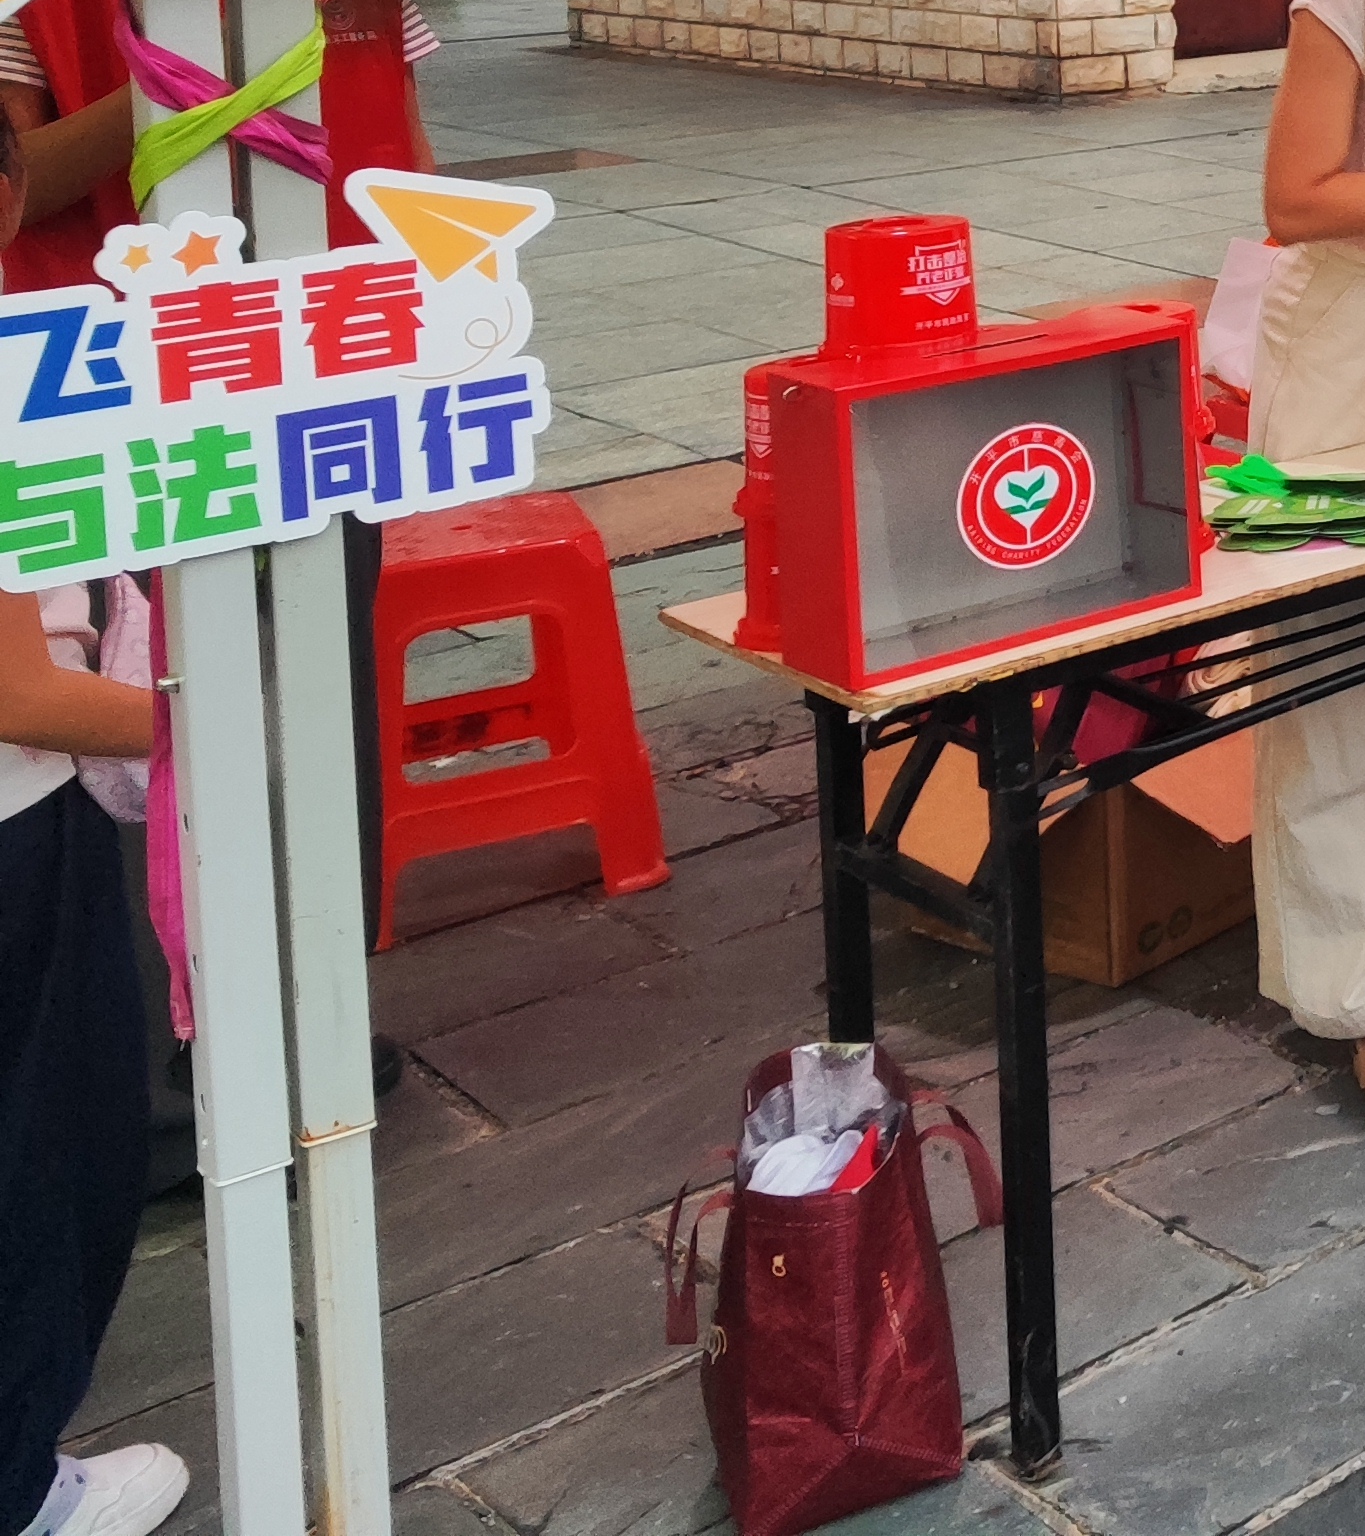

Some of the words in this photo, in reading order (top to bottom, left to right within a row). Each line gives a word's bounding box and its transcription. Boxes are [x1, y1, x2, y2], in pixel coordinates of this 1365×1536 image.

[0, 259, 425, 424] 飞青春
[0, 373, 534, 575] 与法同行
